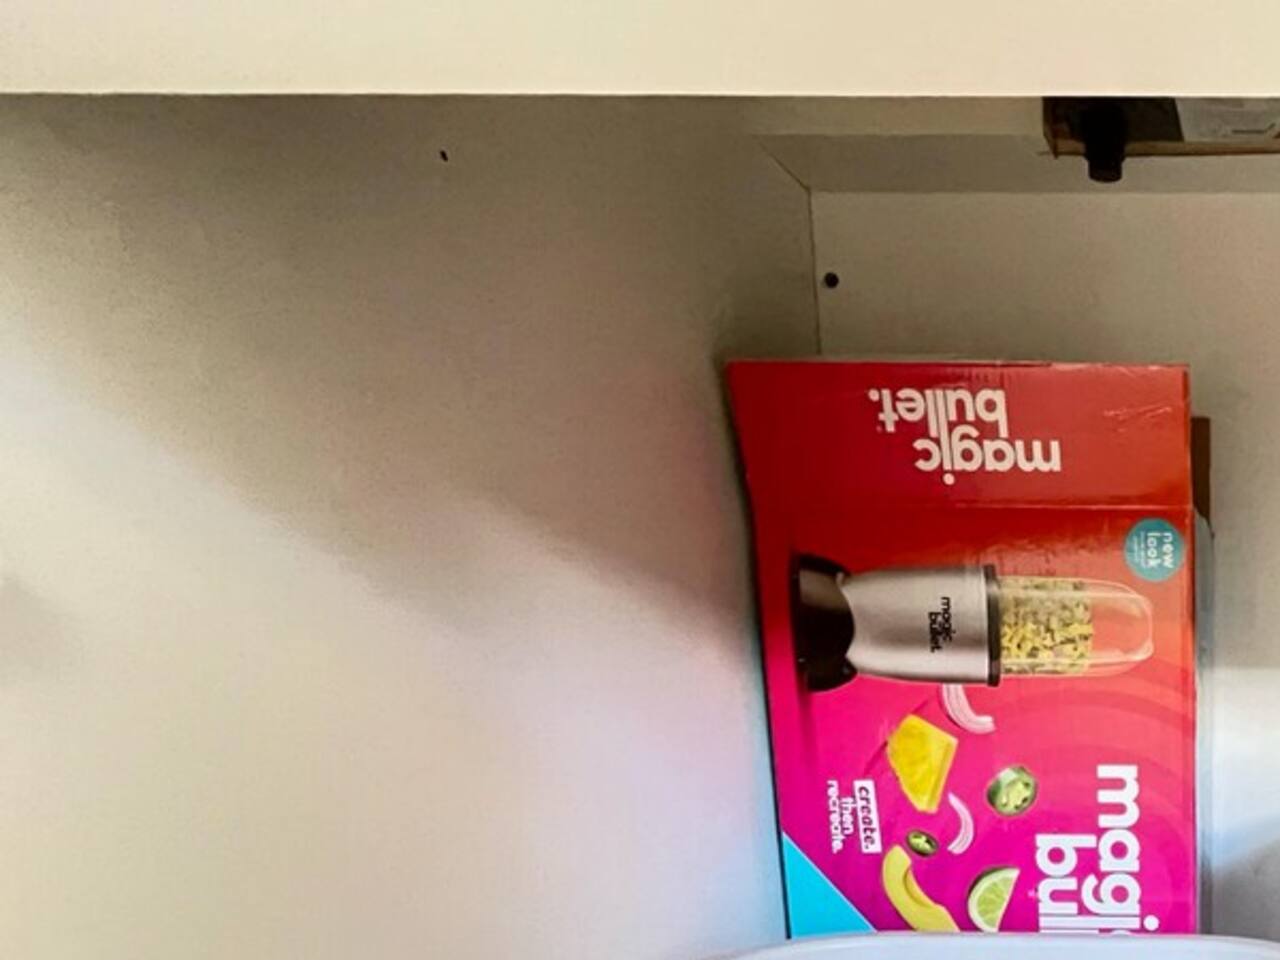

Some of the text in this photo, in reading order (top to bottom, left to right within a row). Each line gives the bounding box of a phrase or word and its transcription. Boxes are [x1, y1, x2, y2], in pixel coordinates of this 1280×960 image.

[868, 387, 1009, 438] bullet.
[913, 424, 1062, 486] magic
[1146, 532, 1162, 569] look
[1162, 532, 1175, 569] new
[940, 596, 957, 642] magic
[826, 779, 846, 855] recreate.
[841, 797, 857, 835] then
[858, 785, 877, 850] create.
[1081, 764, 1160, 934] magi
[1035, 833, 1098, 934] bul
